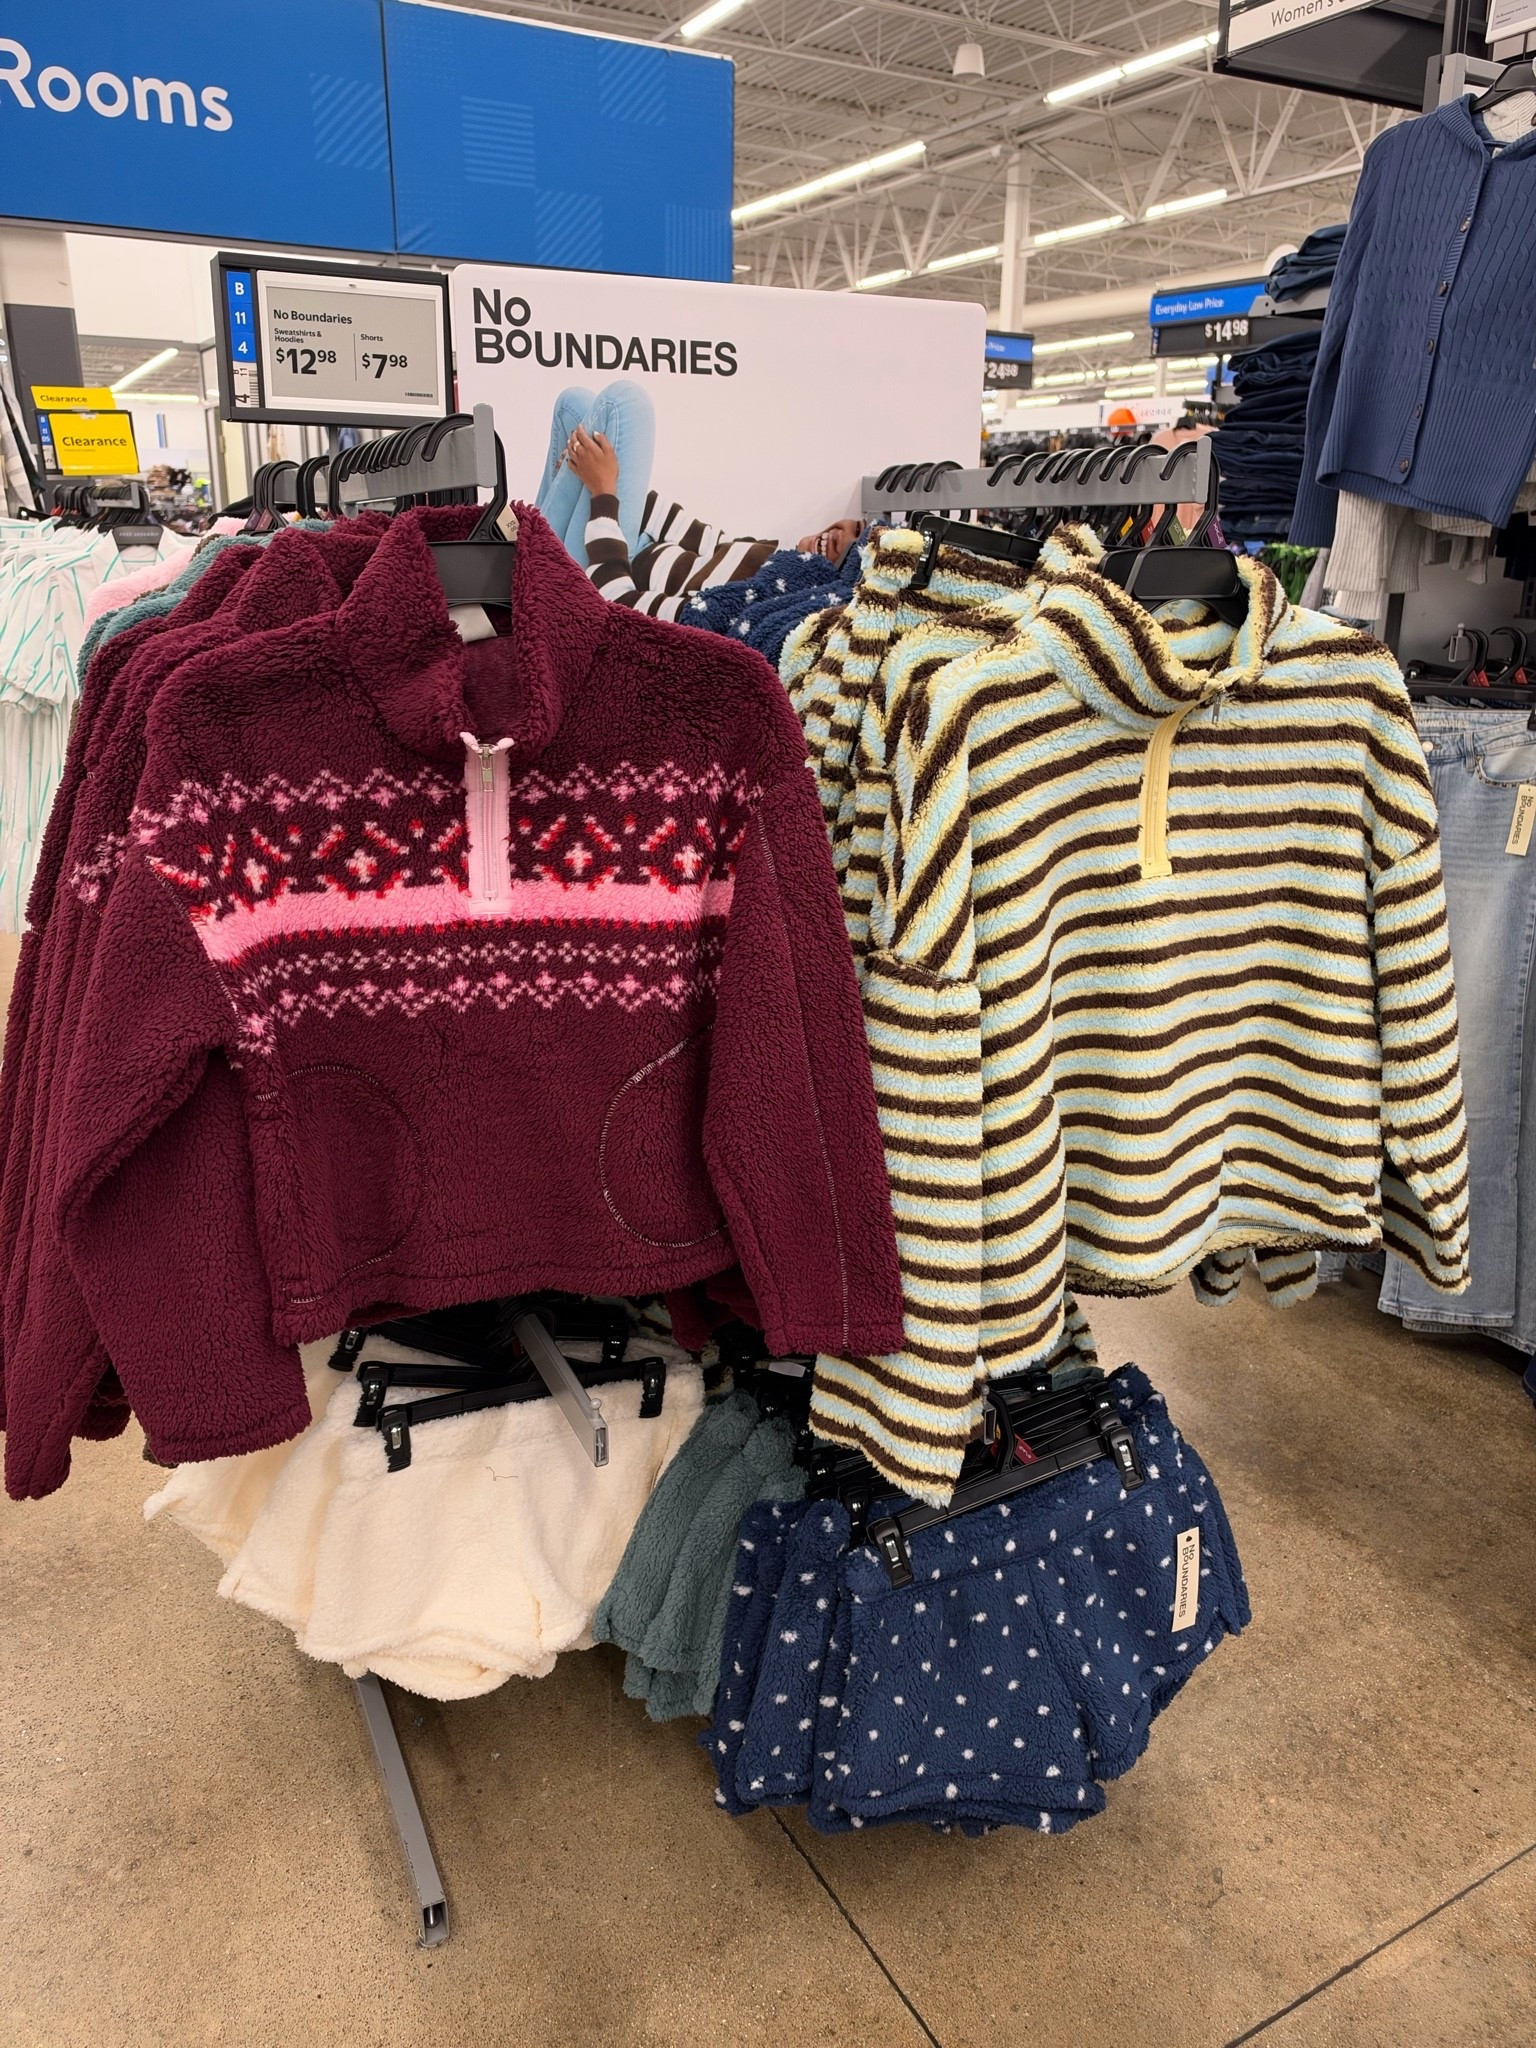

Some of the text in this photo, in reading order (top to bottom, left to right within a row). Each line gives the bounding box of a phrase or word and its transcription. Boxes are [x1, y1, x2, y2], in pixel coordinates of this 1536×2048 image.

[1271, 0, 1333, 27] Womens
[0, 38, 233, 132] Rooms
[235, 282, 245, 295] B
[1155, 297, 1224, 315] Everyday Low Price
[235, 311, 247, 325] 11
[273, 309, 353, 325] No Boundaries
[274, 328, 322, 338] Sweatshirts &
[274, 335, 304, 344] Hoodies
[360, 334, 384, 342] Shorts
[238, 341, 248, 354] 4
[474, 327, 738, 377] BOUNDARIES
[62, 437, 127, 446] Clearance
[1179, 1547, 1190, 1618] BOUNDARIES
